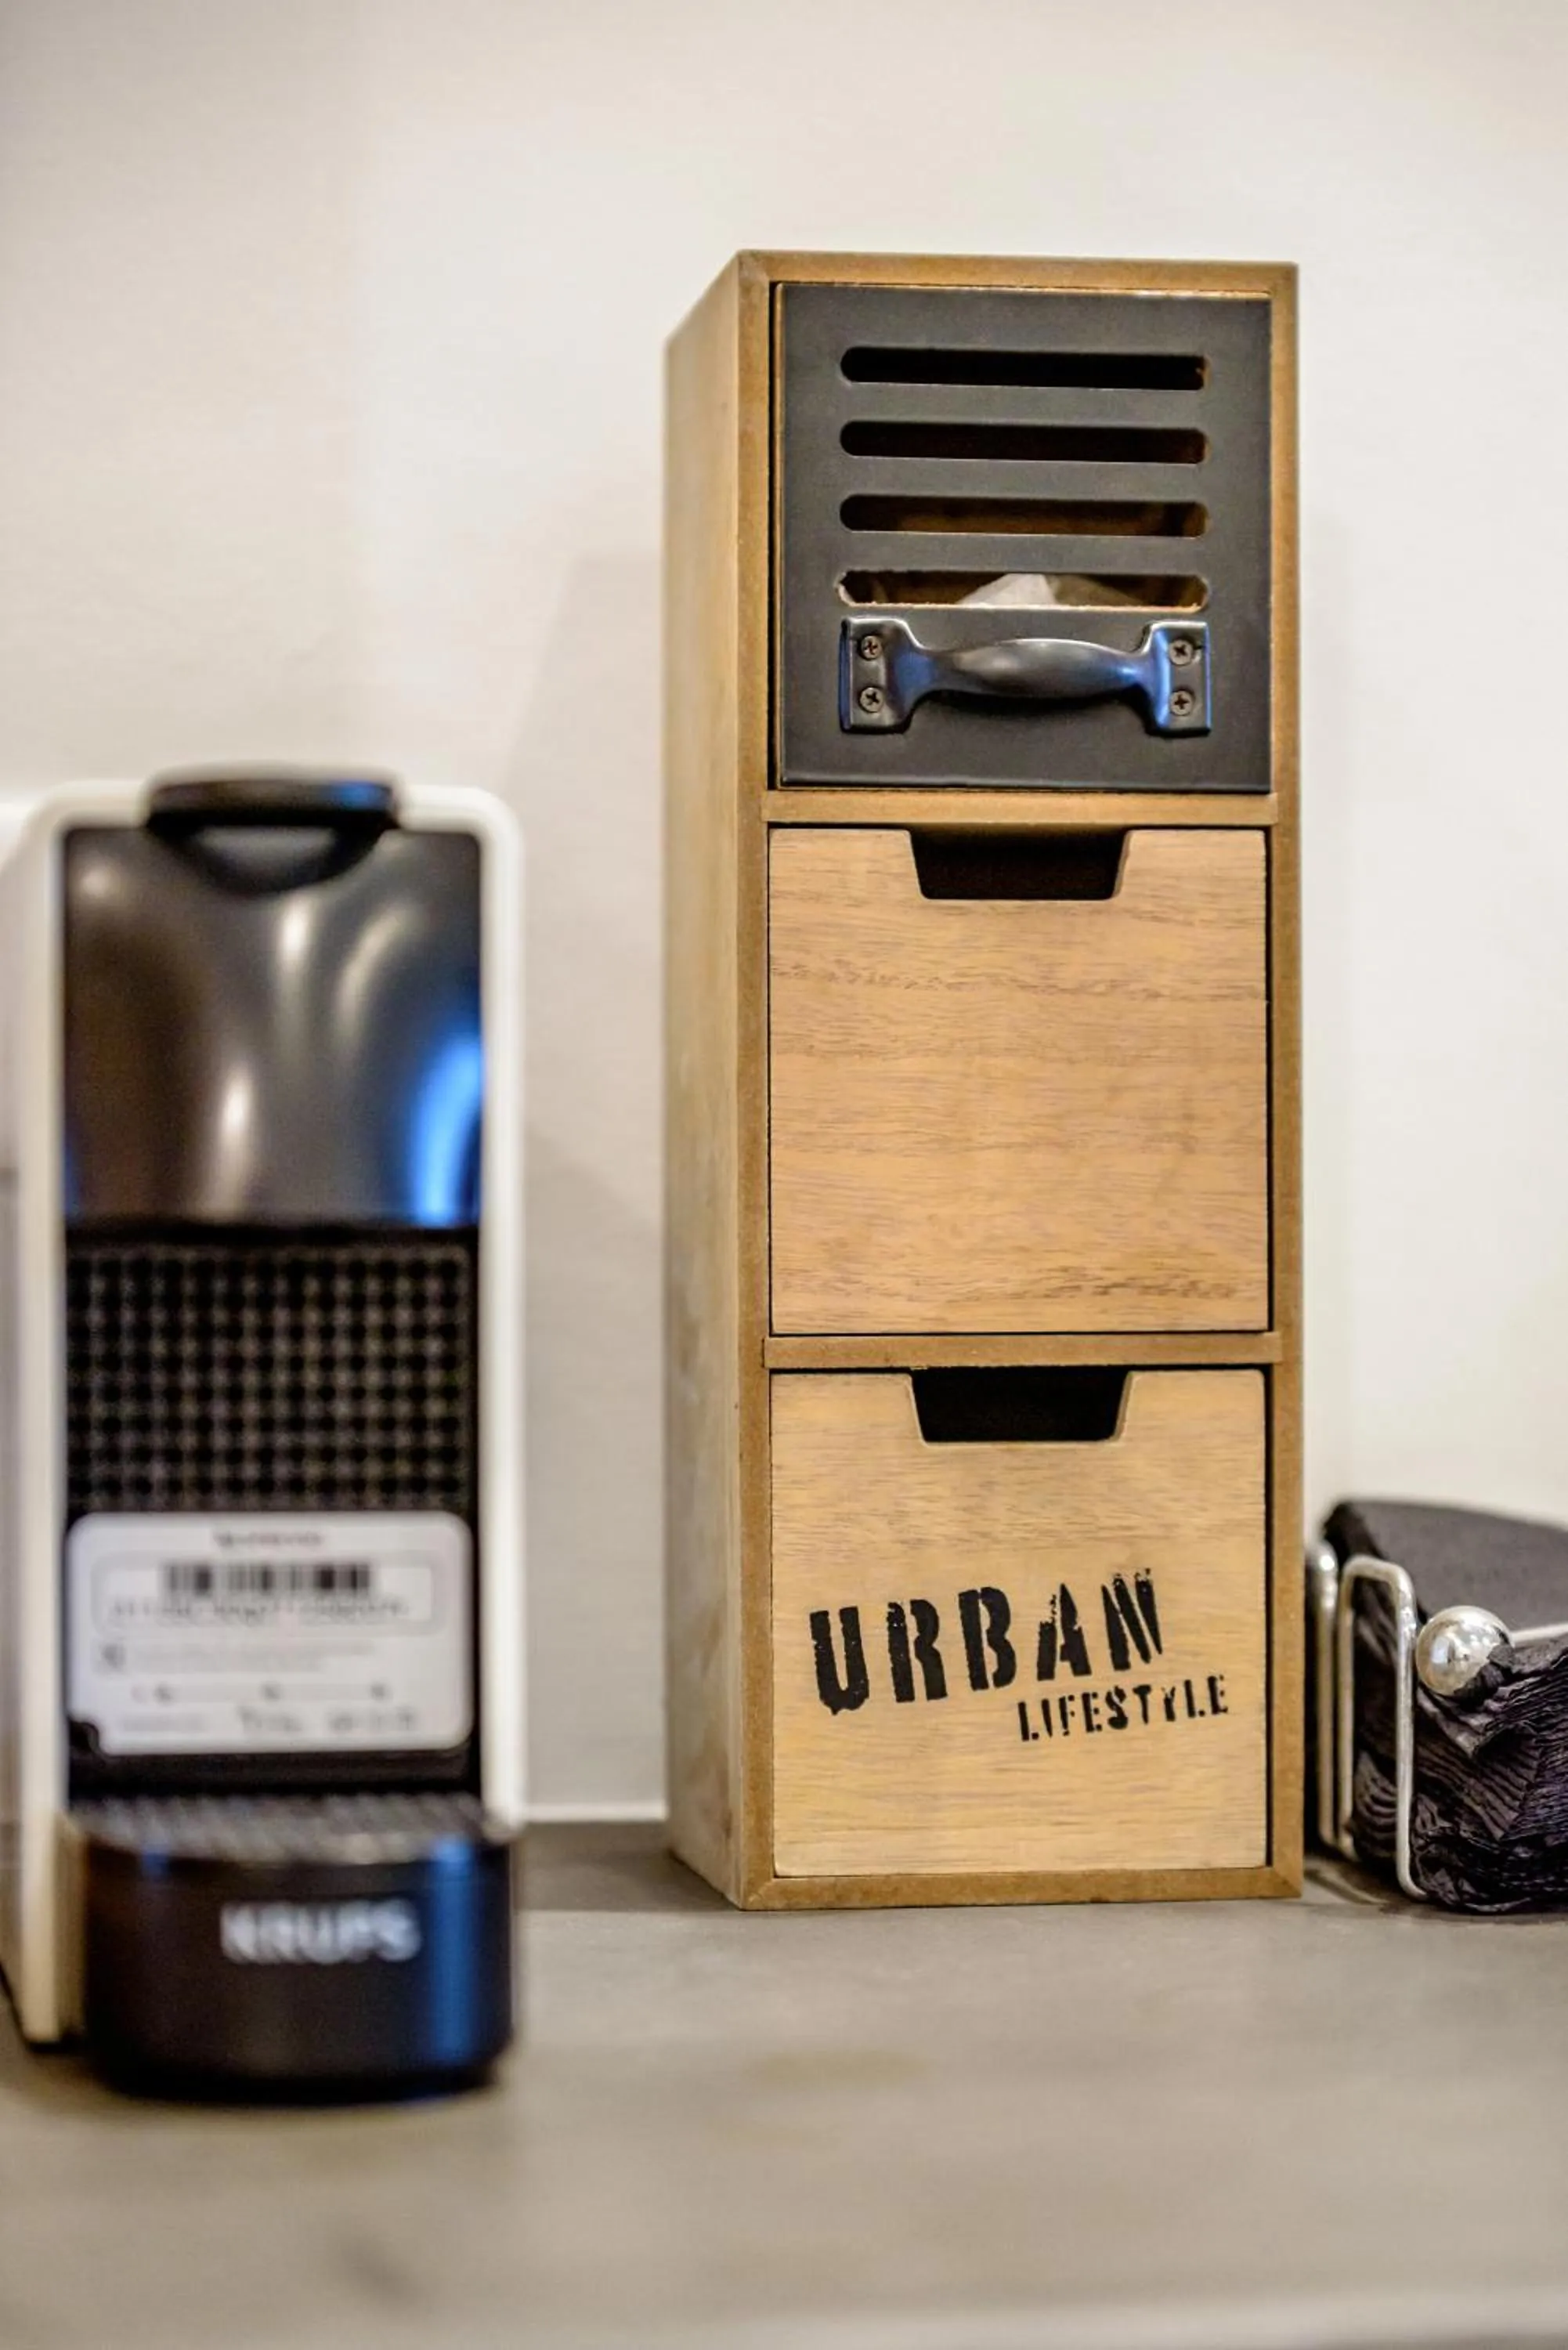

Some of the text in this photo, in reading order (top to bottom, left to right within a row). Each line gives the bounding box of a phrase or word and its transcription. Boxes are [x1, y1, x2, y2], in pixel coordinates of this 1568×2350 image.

[810, 1567, 1163, 1716] URBAN
[1017, 1674, 1228, 1741] LIFESTYLE
[220, 1899, 420, 1964] KRUPS
